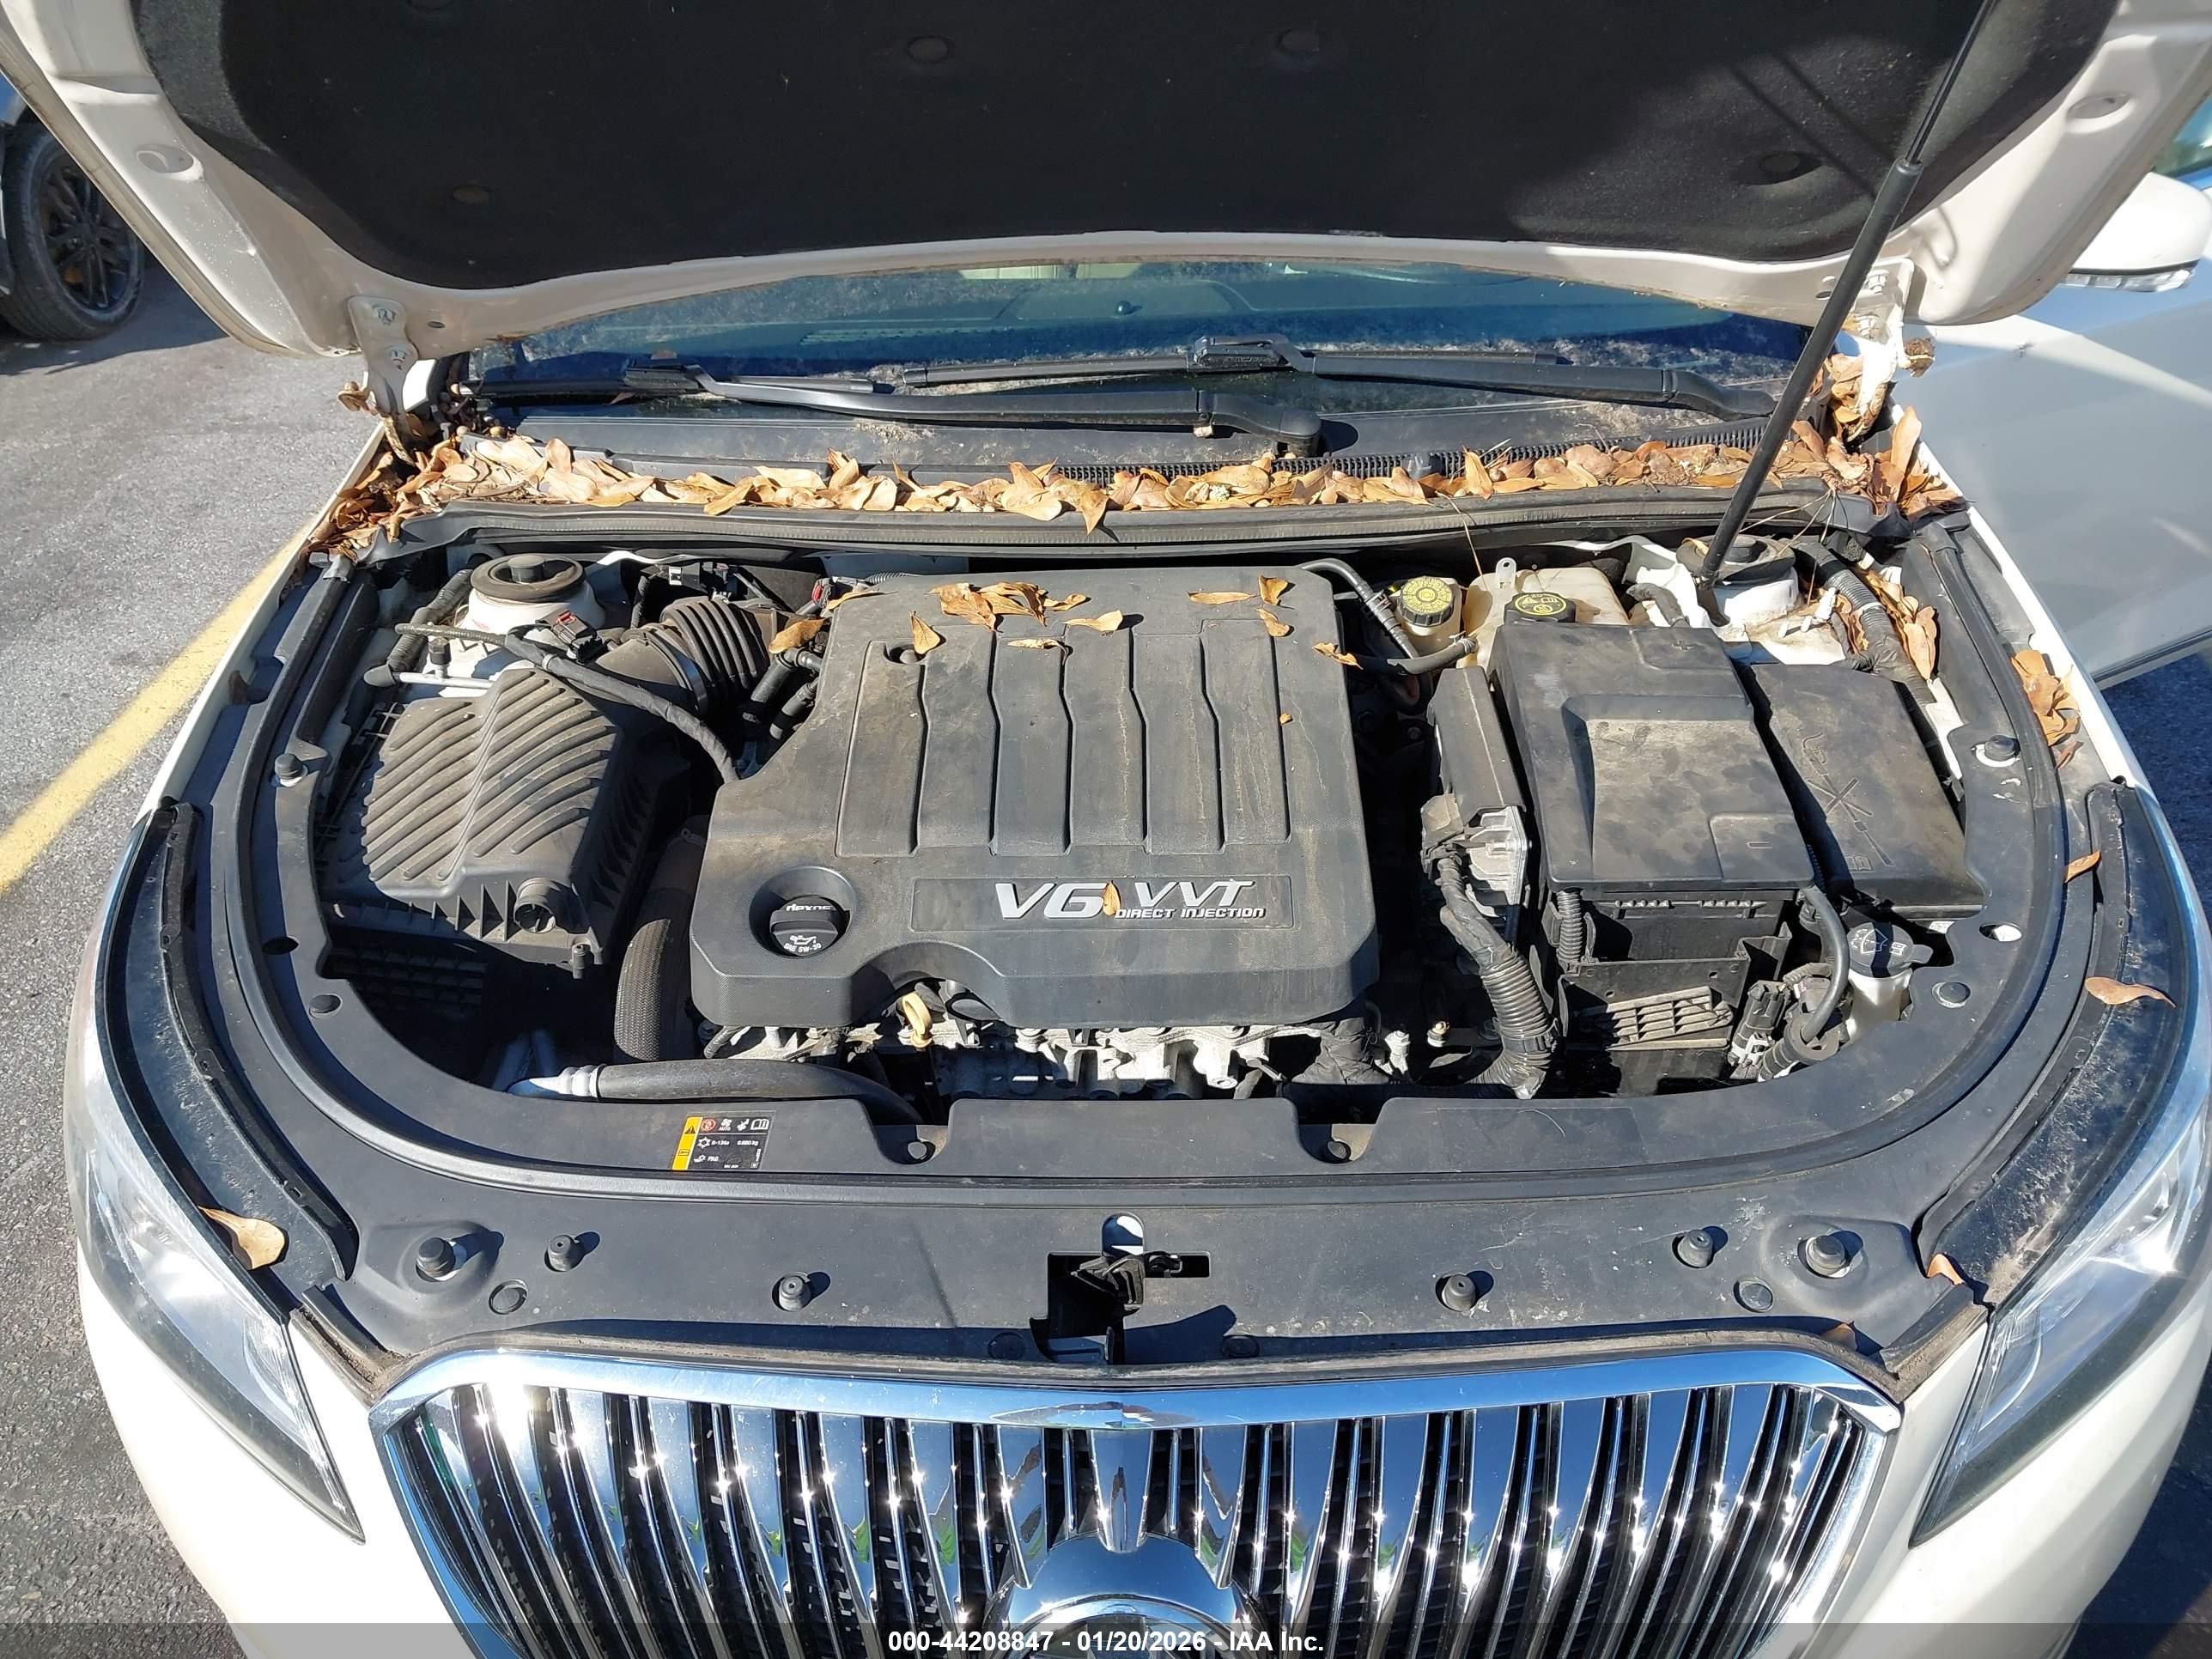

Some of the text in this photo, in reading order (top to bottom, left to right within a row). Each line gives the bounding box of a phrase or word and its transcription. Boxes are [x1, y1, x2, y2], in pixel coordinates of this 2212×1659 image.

[994, 879, 1255, 920] V6 VVT
[1115, 907, 1267, 920] DIRECT INJECTION
[783, 943, 822, 953] SAE 5W-30
